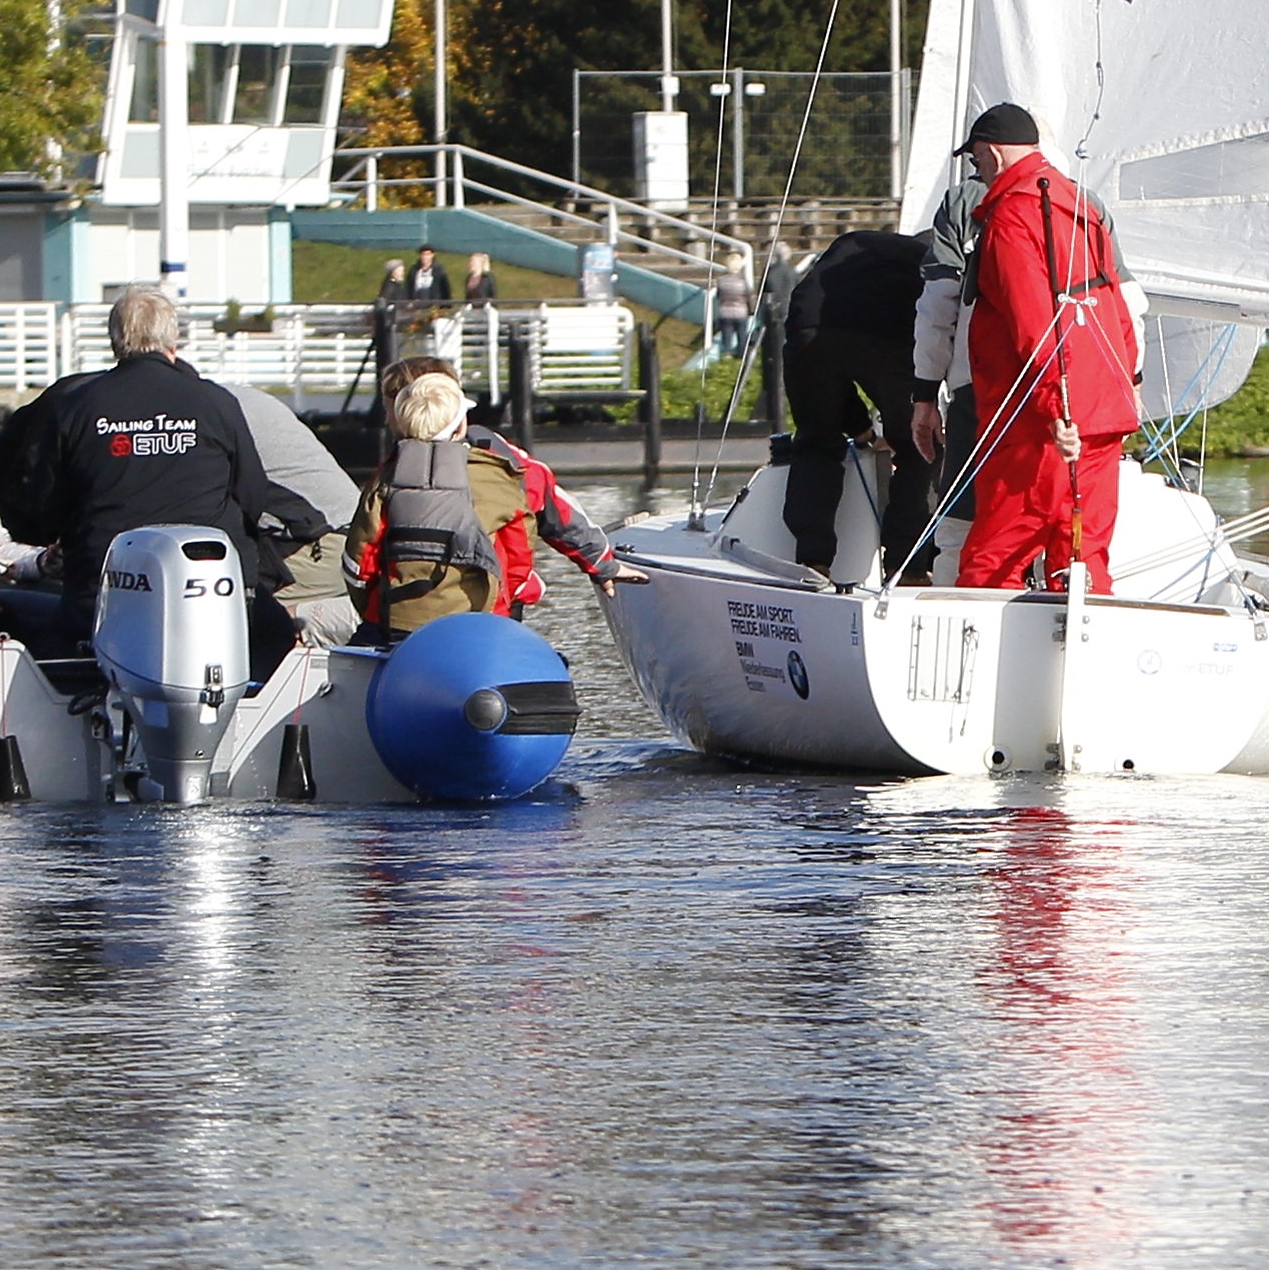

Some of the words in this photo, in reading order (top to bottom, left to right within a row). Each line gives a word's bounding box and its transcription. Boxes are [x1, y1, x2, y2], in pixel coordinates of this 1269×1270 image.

[133, 432, 197, 456] ETUF
[183, 577, 235, 599] 50
[727, 601, 756, 619] FREUDE
[755, 604, 769, 621] AM
[731, 619, 759, 637] FREUDE
[758, 622, 771, 639] AM
[735, 641, 754, 658] BMW
